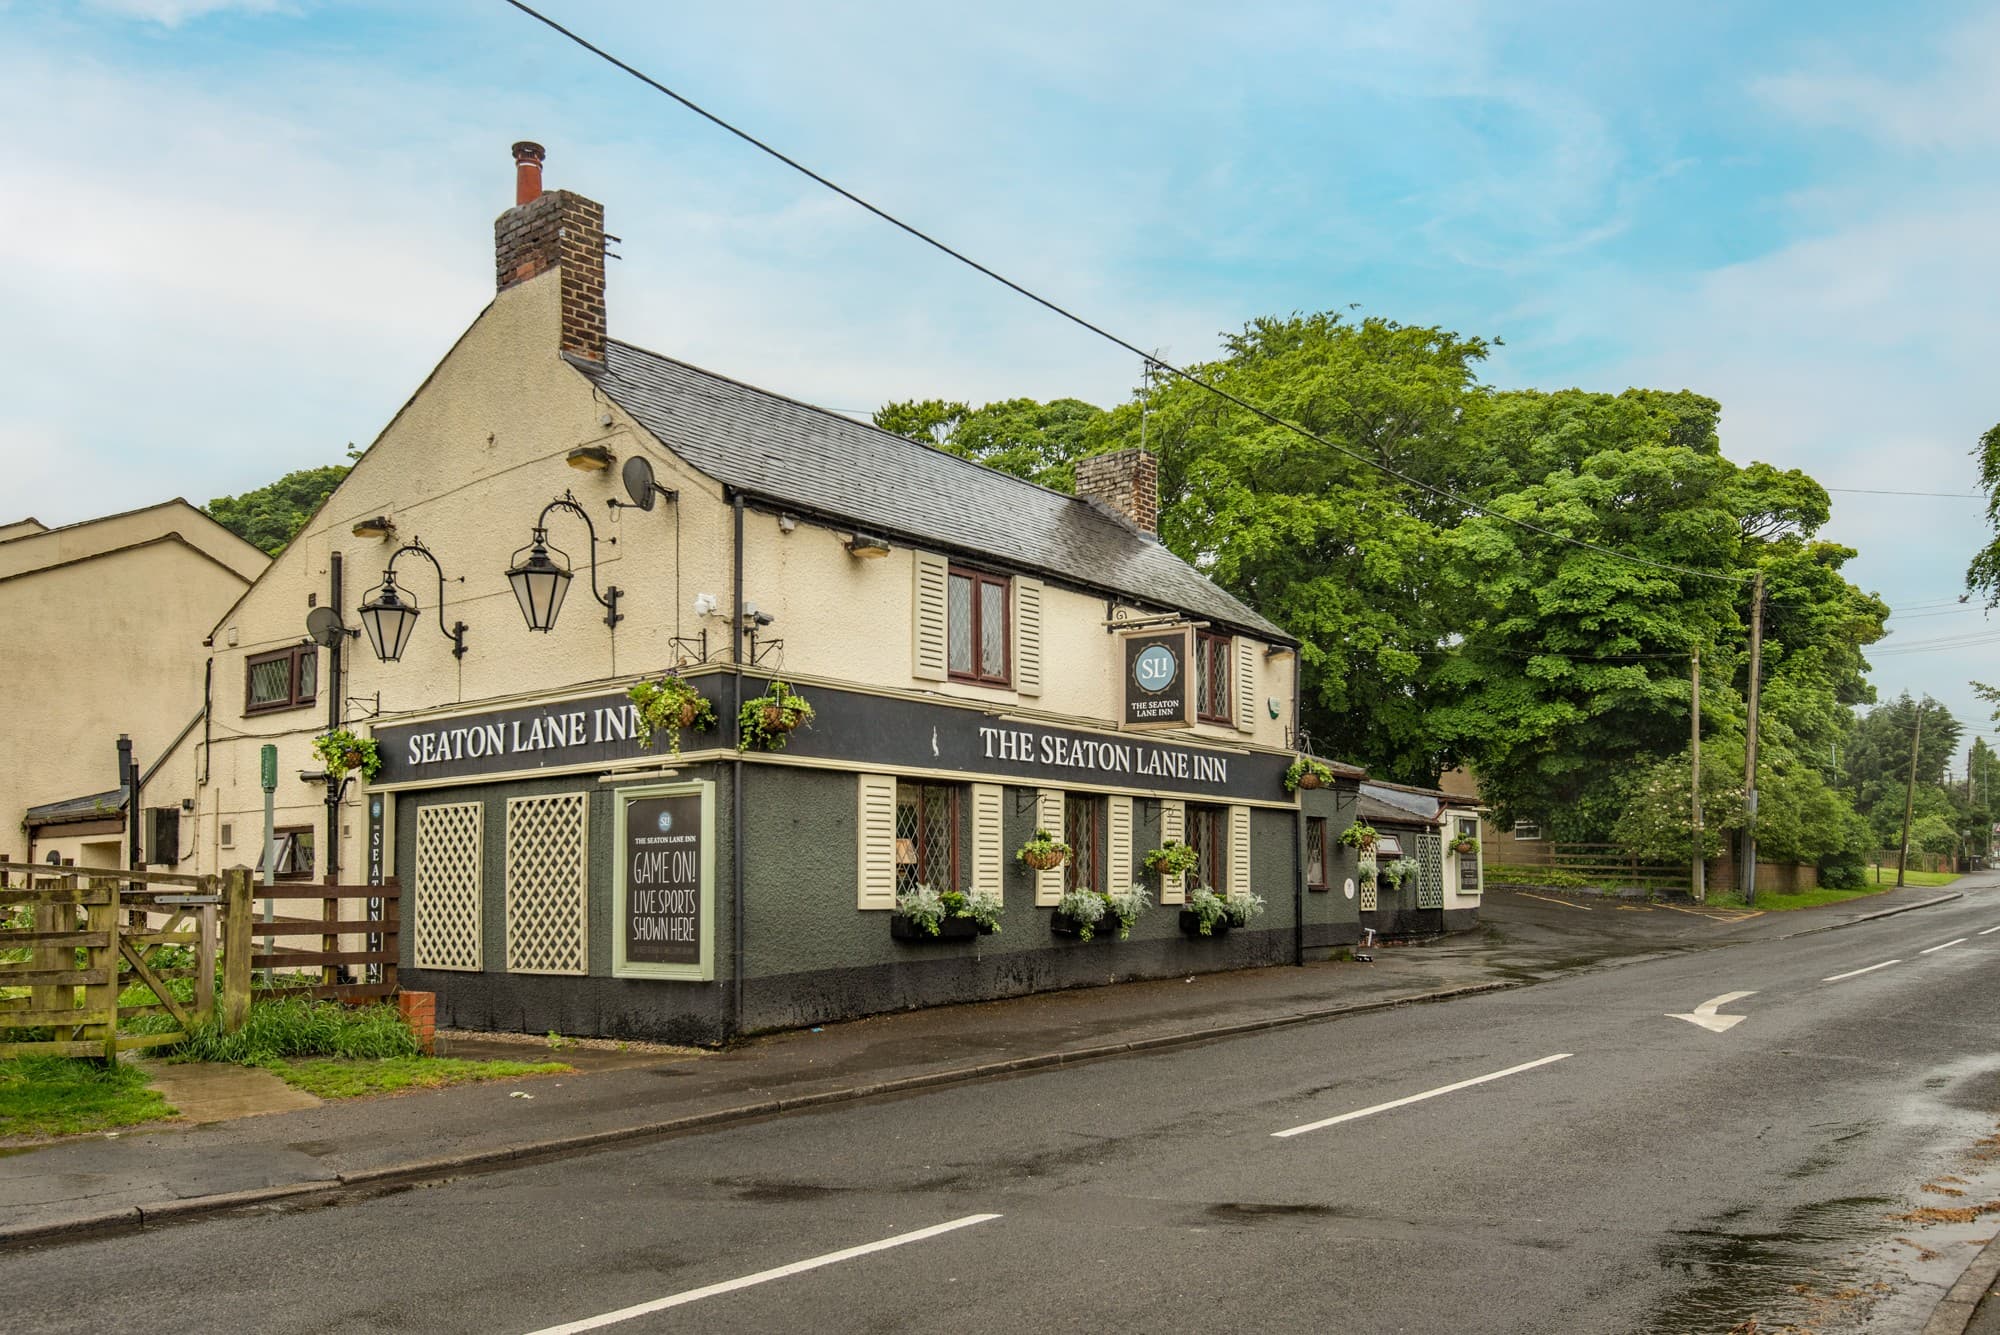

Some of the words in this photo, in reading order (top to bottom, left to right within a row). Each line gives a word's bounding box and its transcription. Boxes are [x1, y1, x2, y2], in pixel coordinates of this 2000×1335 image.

[1131, 702, 1148, 710] THE
[1148, 700, 1180, 709] SEATON
[1136, 709, 1157, 718] LANE
[1158, 707, 1174, 716] INN
[408, 723, 506, 765] SEATON
[512, 711, 587, 753] LANE
[979, 727, 1035, 763] THE
[1040, 735, 1130, 772] SEATON
[1136, 747, 1189, 779] LANE
[1193, 755, 1228, 784] INN
[635, 837, 646, 845] THE
[647, 836, 669, 844] SEATON
[669, 835, 684, 843] LANE
[634, 851, 670, 884] GAME
[673, 851, 696, 884] ON!
[634, 890, 656, 914] LIVE
[658, 889, 696, 914] SPORTS
[633, 916, 668, 941] SHOWN
[671, 917, 695, 942] HERE
